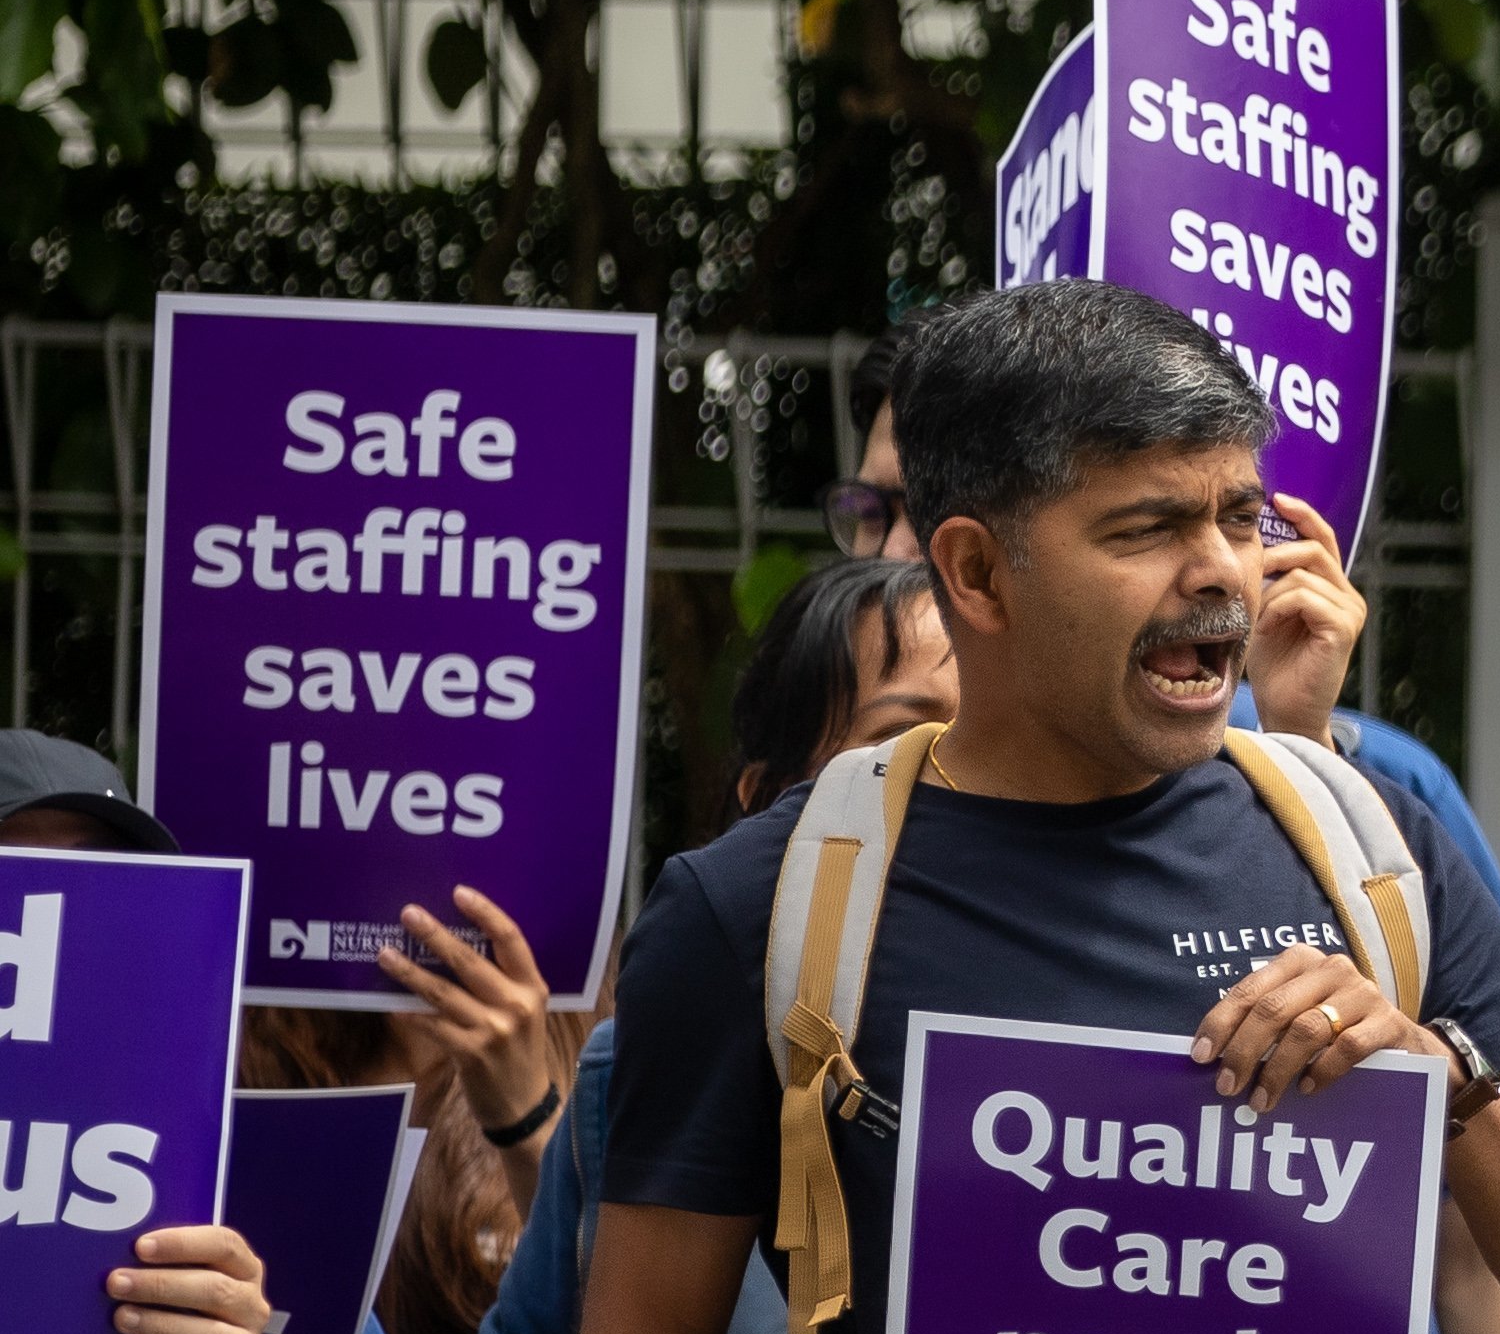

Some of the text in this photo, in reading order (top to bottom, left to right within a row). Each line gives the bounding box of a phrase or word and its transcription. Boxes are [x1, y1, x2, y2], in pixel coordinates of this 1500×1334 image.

[1128, 78, 1378, 258] staffing
[1169, 209, 1353, 334] saves
[283, 390, 517, 481] Safe
[192, 508, 601, 632] staffing
[243, 646, 536, 721] saves
[267, 741, 504, 836] lives
[1172, 922, 1342, 957] HILFIGER
[1196, 963, 1239, 978] EST.
[970, 1089, 1375, 1224] Quality
[1038, 1207, 1286, 1304] Care
